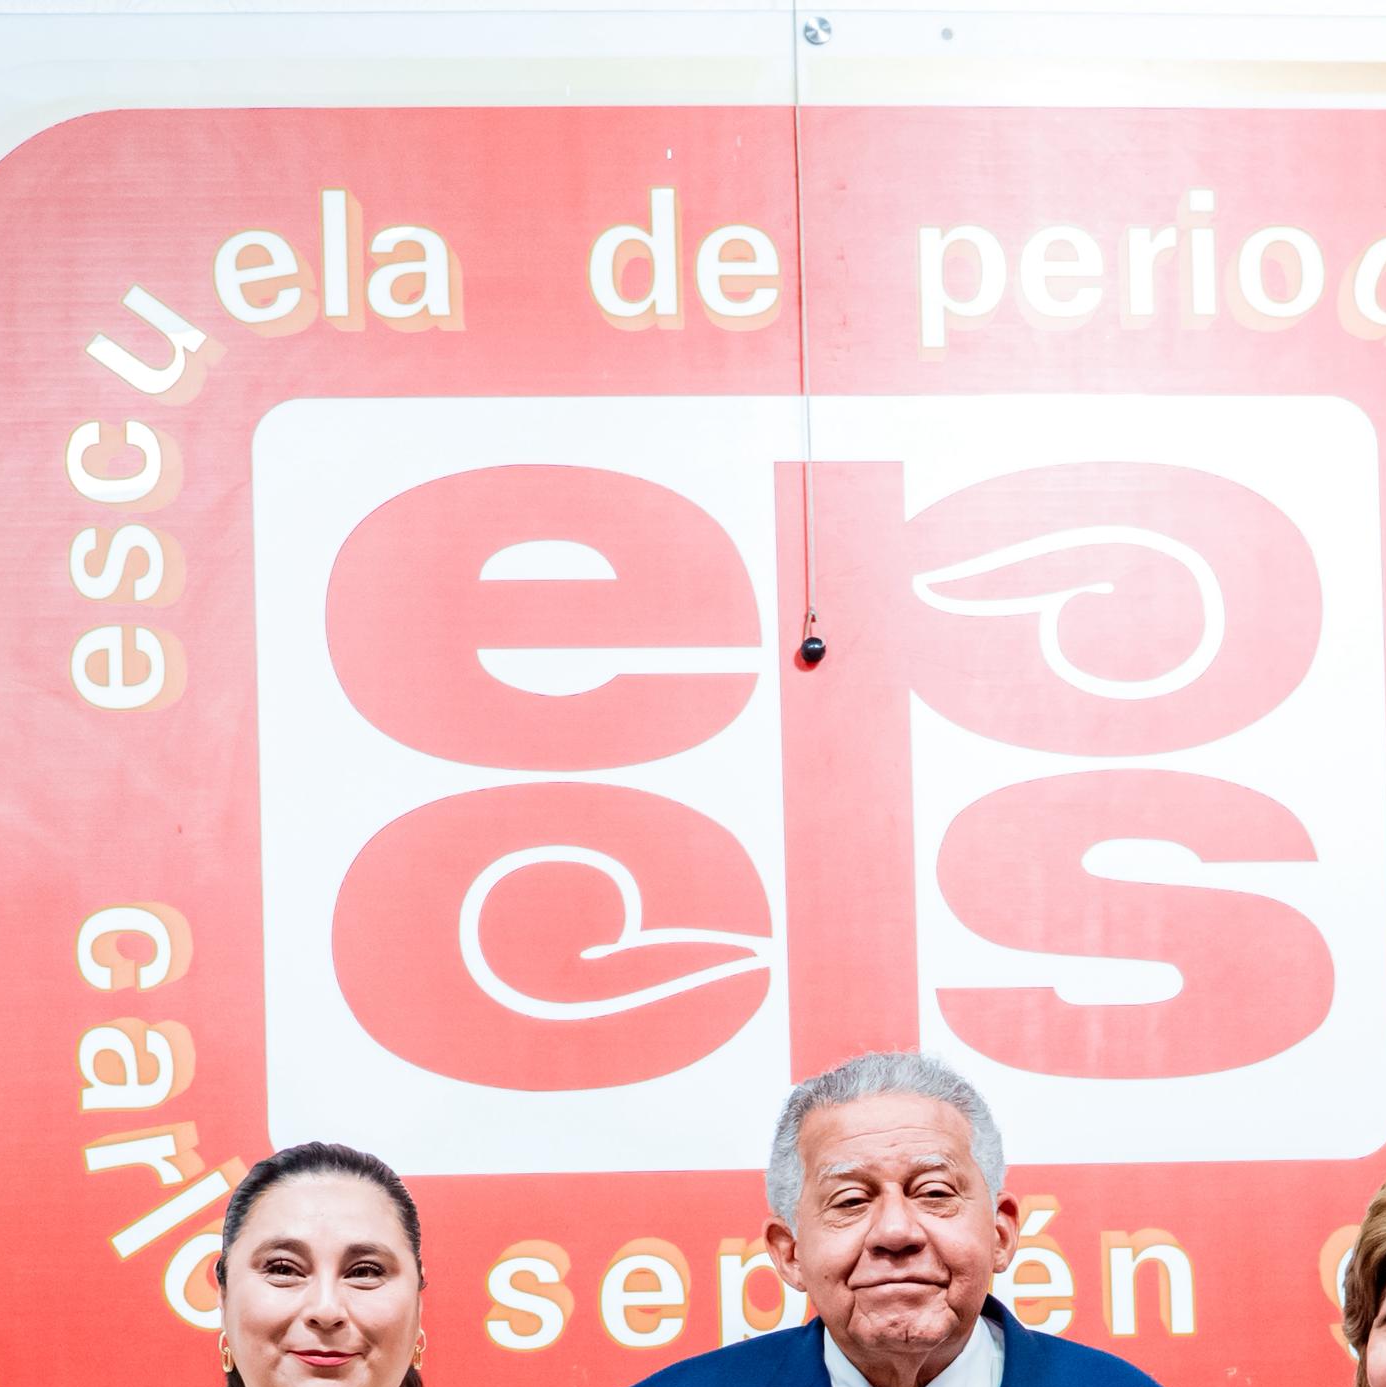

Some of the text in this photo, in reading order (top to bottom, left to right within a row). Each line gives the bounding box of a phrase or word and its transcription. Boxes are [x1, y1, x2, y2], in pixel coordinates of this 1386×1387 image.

[64, 186, 453, 711] escuela
[587, 187, 781, 318] de
[485, 1209, 1197, 1350] sepén
